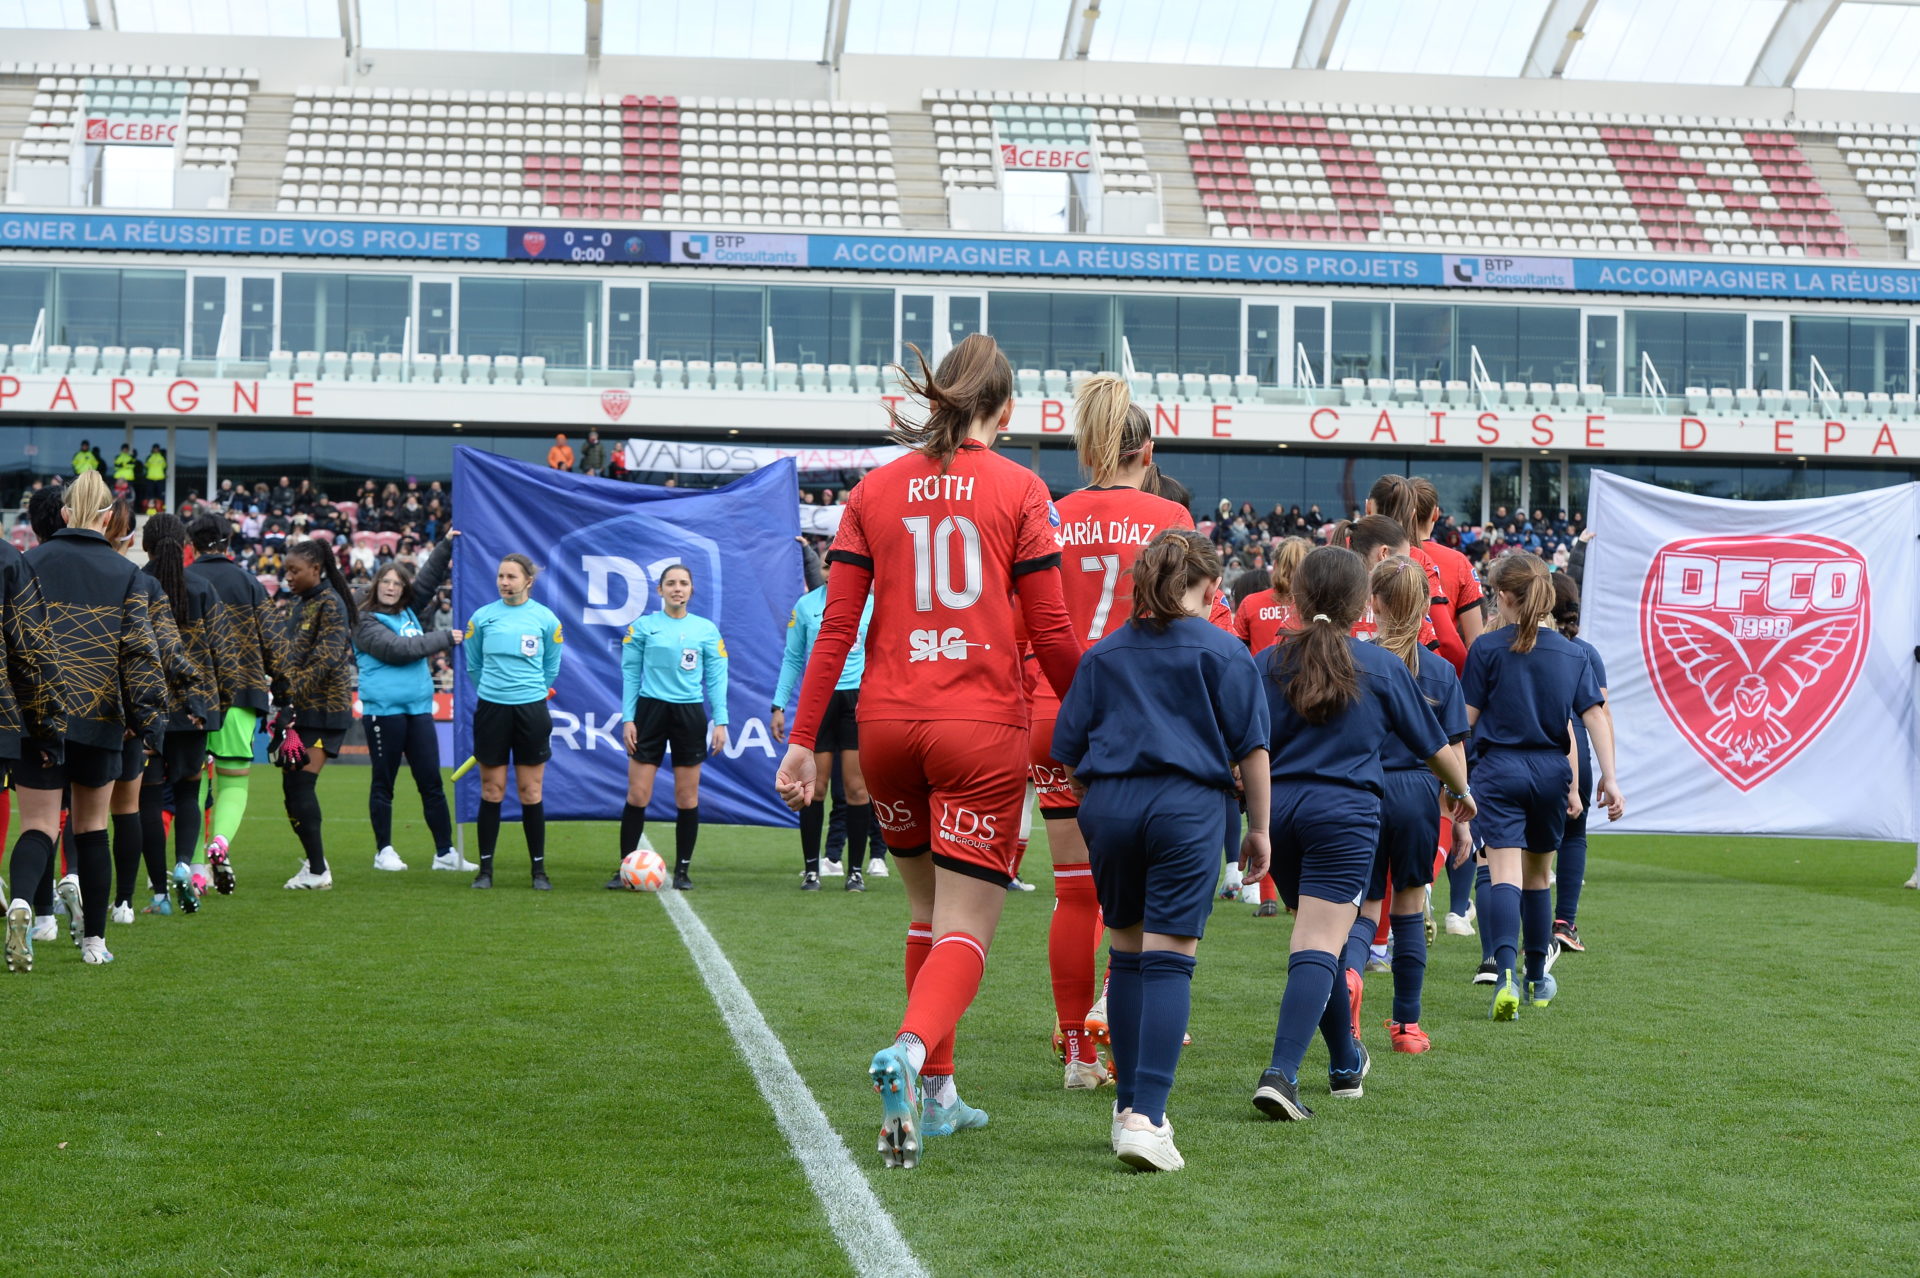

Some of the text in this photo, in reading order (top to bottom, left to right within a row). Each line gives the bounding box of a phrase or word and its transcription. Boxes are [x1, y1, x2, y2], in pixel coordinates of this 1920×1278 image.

[1019, 150, 1090, 169] CEBFC
[0, 220, 481, 251] GNER LA RÉUSSITE DE VOS PROJETS
[563, 231, 575, 246] 0
[601, 232, 612, 247] 0
[715, 235, 745, 249] BTP
[571, 247, 605, 262] 0:00
[715, 249, 798, 263] Consultants
[833, 242, 1419, 279] ACCOMPAGNER LA RÉUSSITE DE VOS PROJETS
[1484, 258, 1513, 272] BTP
[1485, 272, 1565, 286] Consultants
[1600, 266, 1920, 294] ACCOMPAGNER LA RÉUSSI
[0, 375, 315, 416] PARGNE
[881, 395, 1233, 438] TBNE
[1309, 407, 1606, 448] CAISSE
[627, 440, 758, 472] VAMOS
[907, 474, 975, 503] ROTH
[1060, 514, 1156, 546] ARÍA DÍAZ
[901, 515, 983, 612] 10
[1080, 553, 1120, 640] 7
[1657, 551, 1866, 614] DFCO
[1730, 614, 1793, 640] 1998
[908, 626, 968, 662] SIG
[940, 803, 997, 841] LDS
[955, 836, 992, 851] GROUPE
